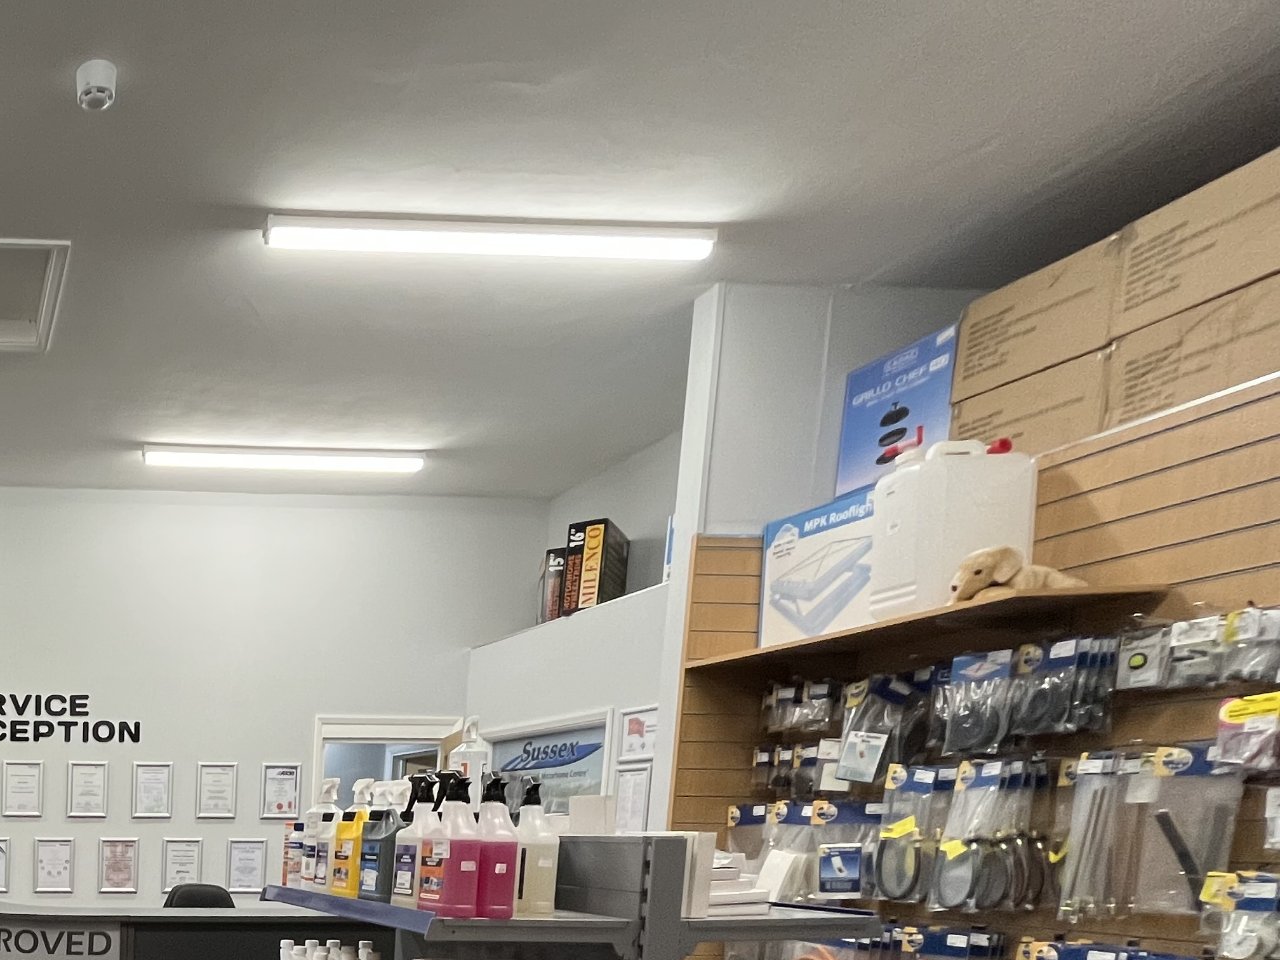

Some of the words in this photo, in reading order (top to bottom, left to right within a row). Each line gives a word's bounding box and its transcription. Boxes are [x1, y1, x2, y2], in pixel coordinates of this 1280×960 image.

[804, 514, 827, 532] MPK
[830, 503, 872, 523] Roofligh
[581, 527, 602, 605] MILENCO
[521, 741, 579, 761] Sussex
